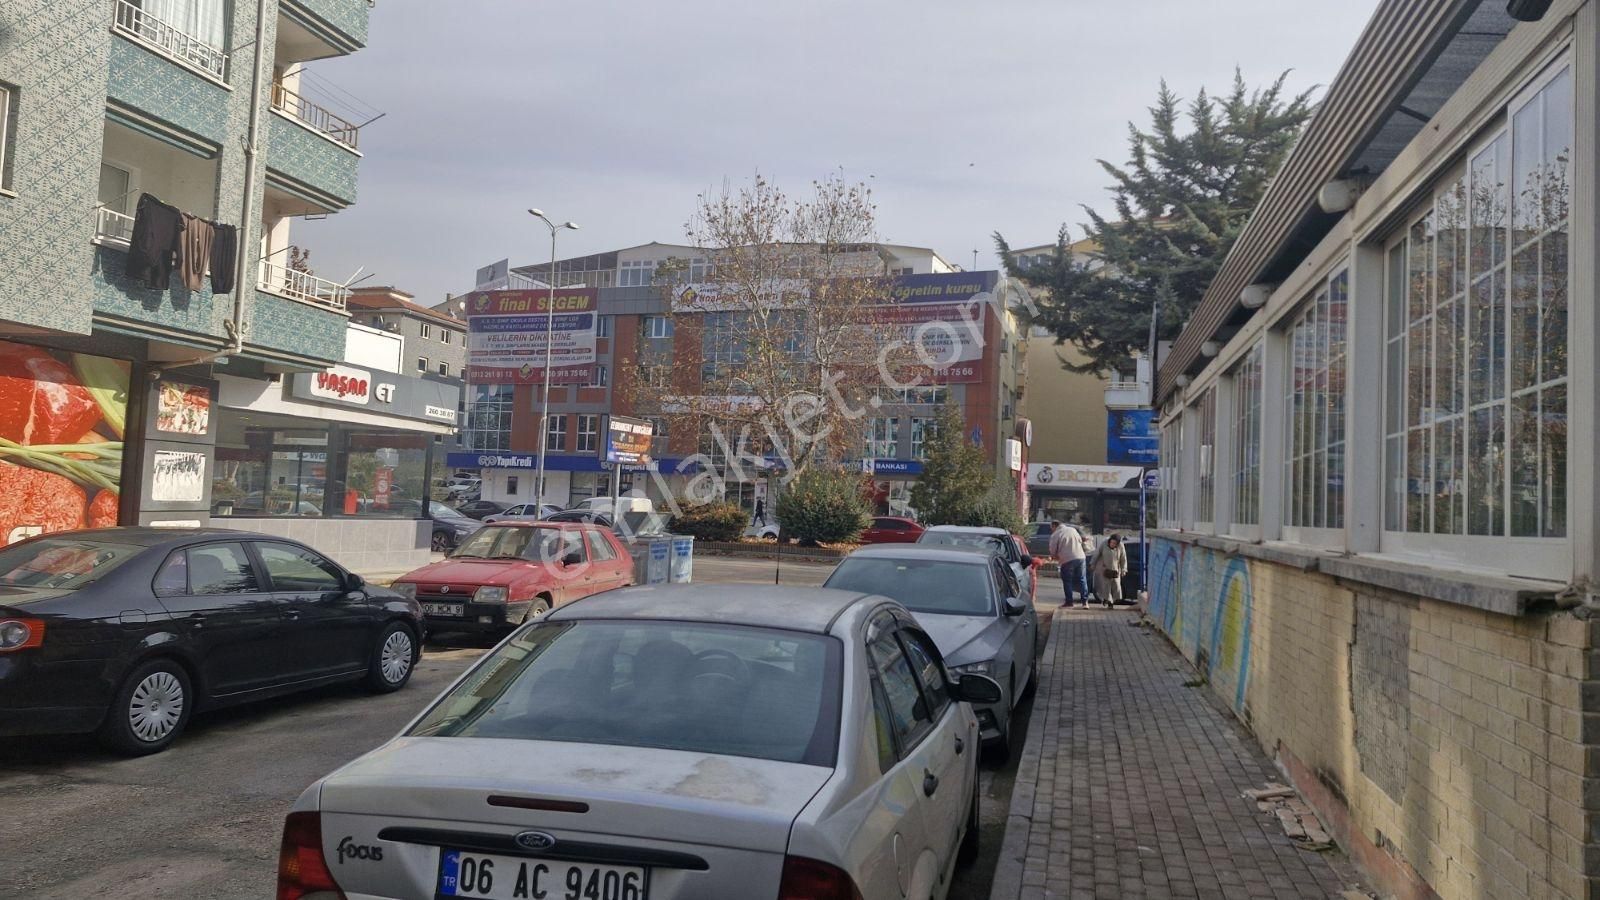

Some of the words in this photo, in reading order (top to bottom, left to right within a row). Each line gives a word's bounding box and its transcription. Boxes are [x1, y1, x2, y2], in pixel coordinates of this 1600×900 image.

[896, 285, 942, 299] öğretim
[946, 283, 982, 295] kursu
[499, 297, 531, 312] final
[536, 295, 590, 310] SEGEM
[487, 333, 527, 342] VELİLERİN
[950, 367, 961, 376] 75
[962, 367, 974, 376] 66
[317, 371, 368, 397] YAŞAR
[496, 455, 532, 468] YapıKredi
[875, 463, 908, 471] BANKASI
[1057, 469, 1119, 483] ERCİYES
[443, 875, 456, 888] TR
[459, 856, 494, 894] 06
[513, 863, 550, 899] AC
[565, 870, 643, 900] 9406
